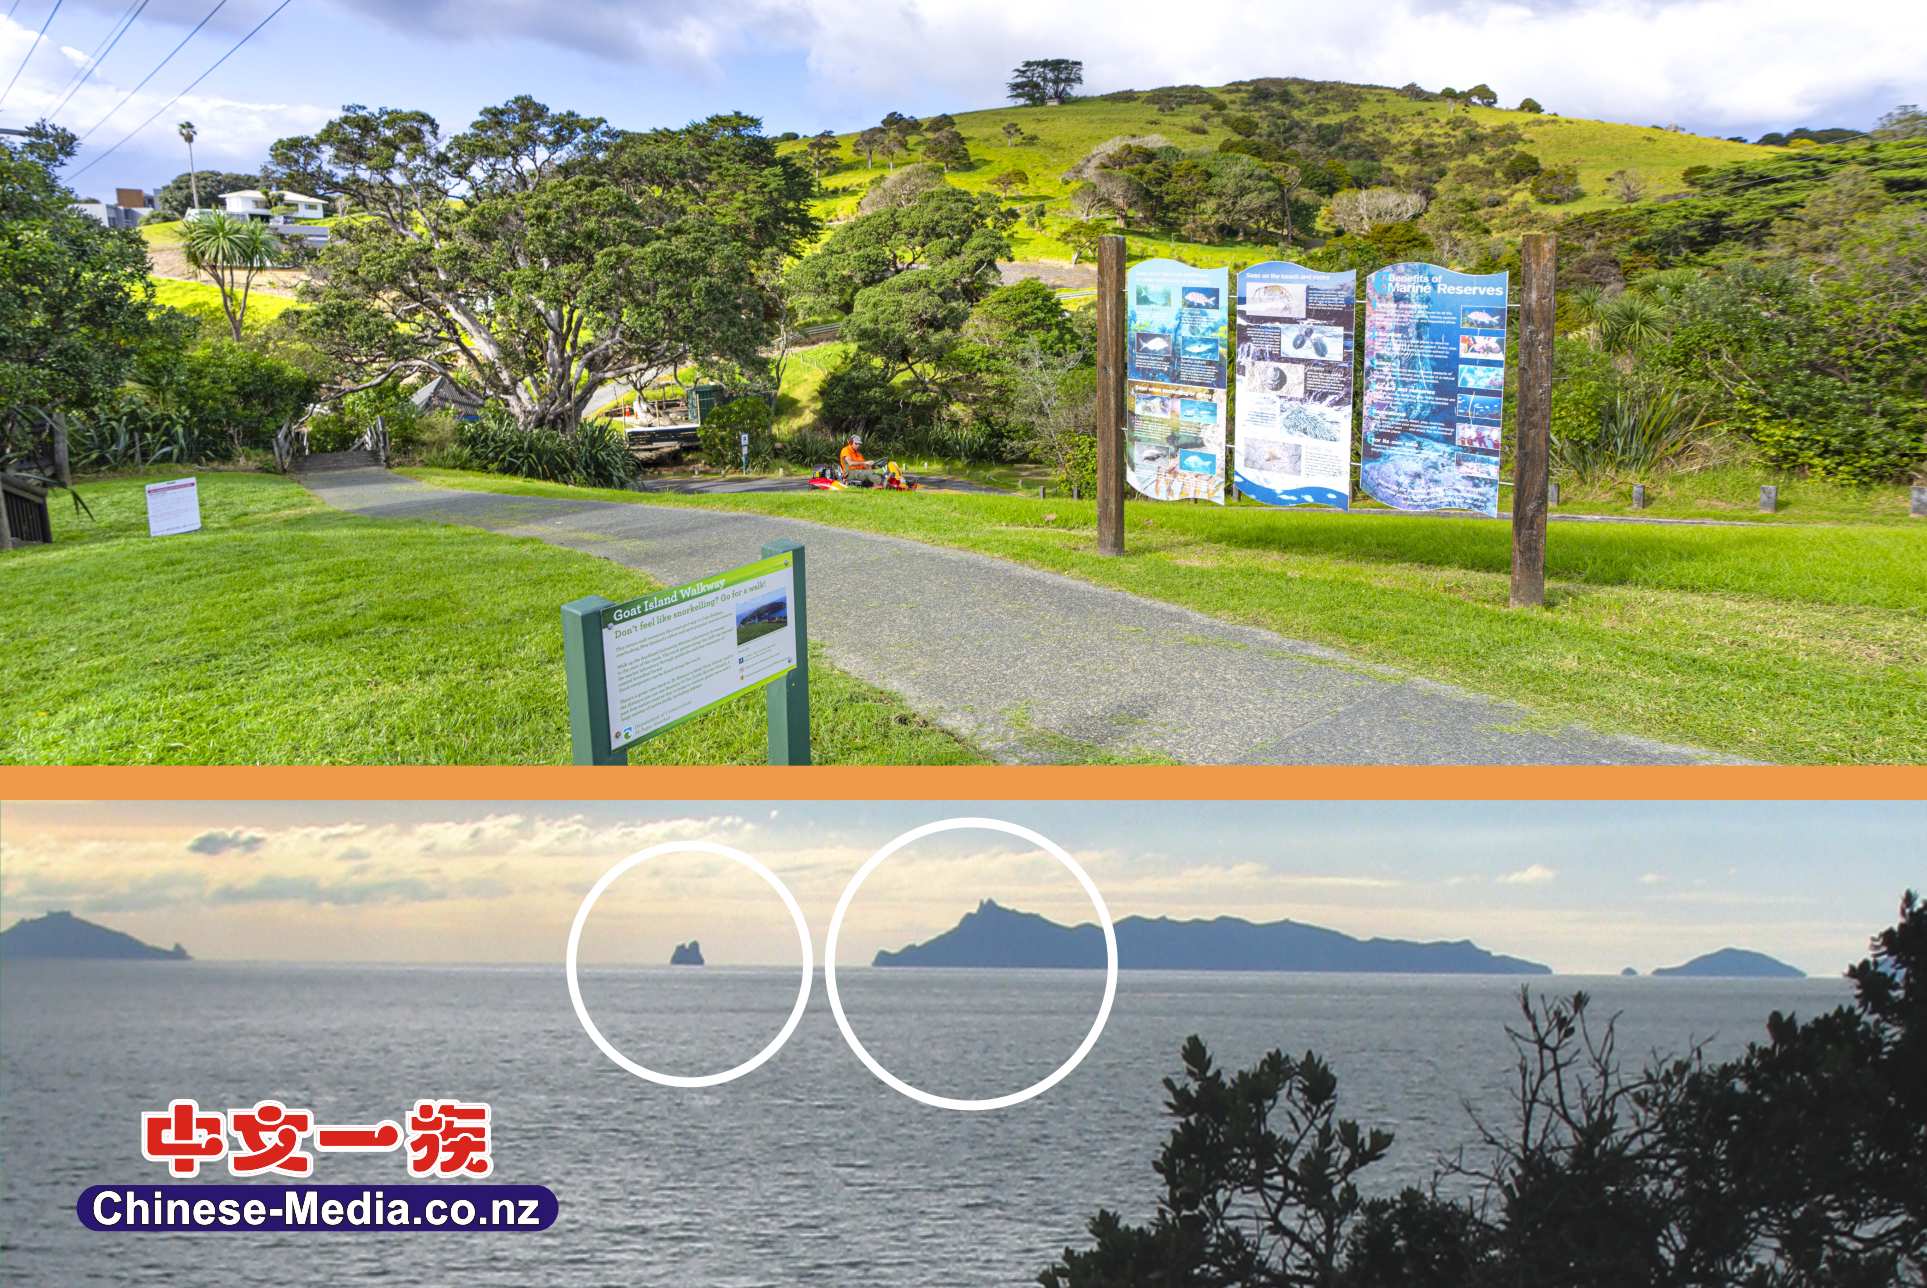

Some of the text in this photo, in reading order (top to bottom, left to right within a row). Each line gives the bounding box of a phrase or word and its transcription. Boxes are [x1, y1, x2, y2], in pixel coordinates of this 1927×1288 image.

[1387, 282, 1504, 297] Marine Reserves
[1388, 273, 1443, 284] Benefits of
[613, 579, 726, 621] Goat Island Walkway
[615, 623, 639, 640] Don't
[639, 616, 655, 631] feel
[656, 611, 673, 626] like
[673, 594, 720, 619] snorkelling?
[720, 593, 732, 603] Go
[730, 588, 743, 602] for
